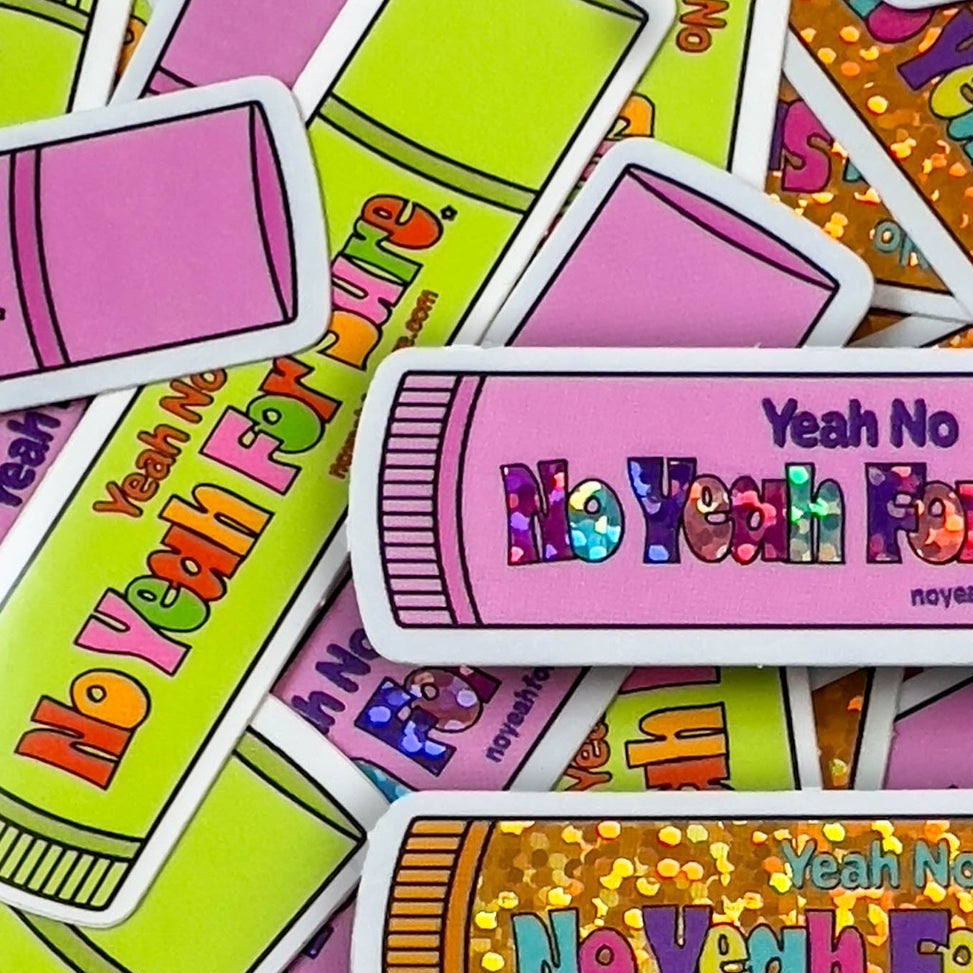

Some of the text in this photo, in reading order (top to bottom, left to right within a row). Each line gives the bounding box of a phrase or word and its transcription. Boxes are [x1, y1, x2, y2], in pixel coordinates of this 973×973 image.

[93, 423, 191, 518] Yeah
[762, 397, 959, 449] Yeah No
[499, 458, 625, 567] No
[626, 456, 847, 566] Yeah
[74, 482, 275, 677] Yeah
[14, 668, 151, 791] No
[783, 839, 899, 891] Yeah
